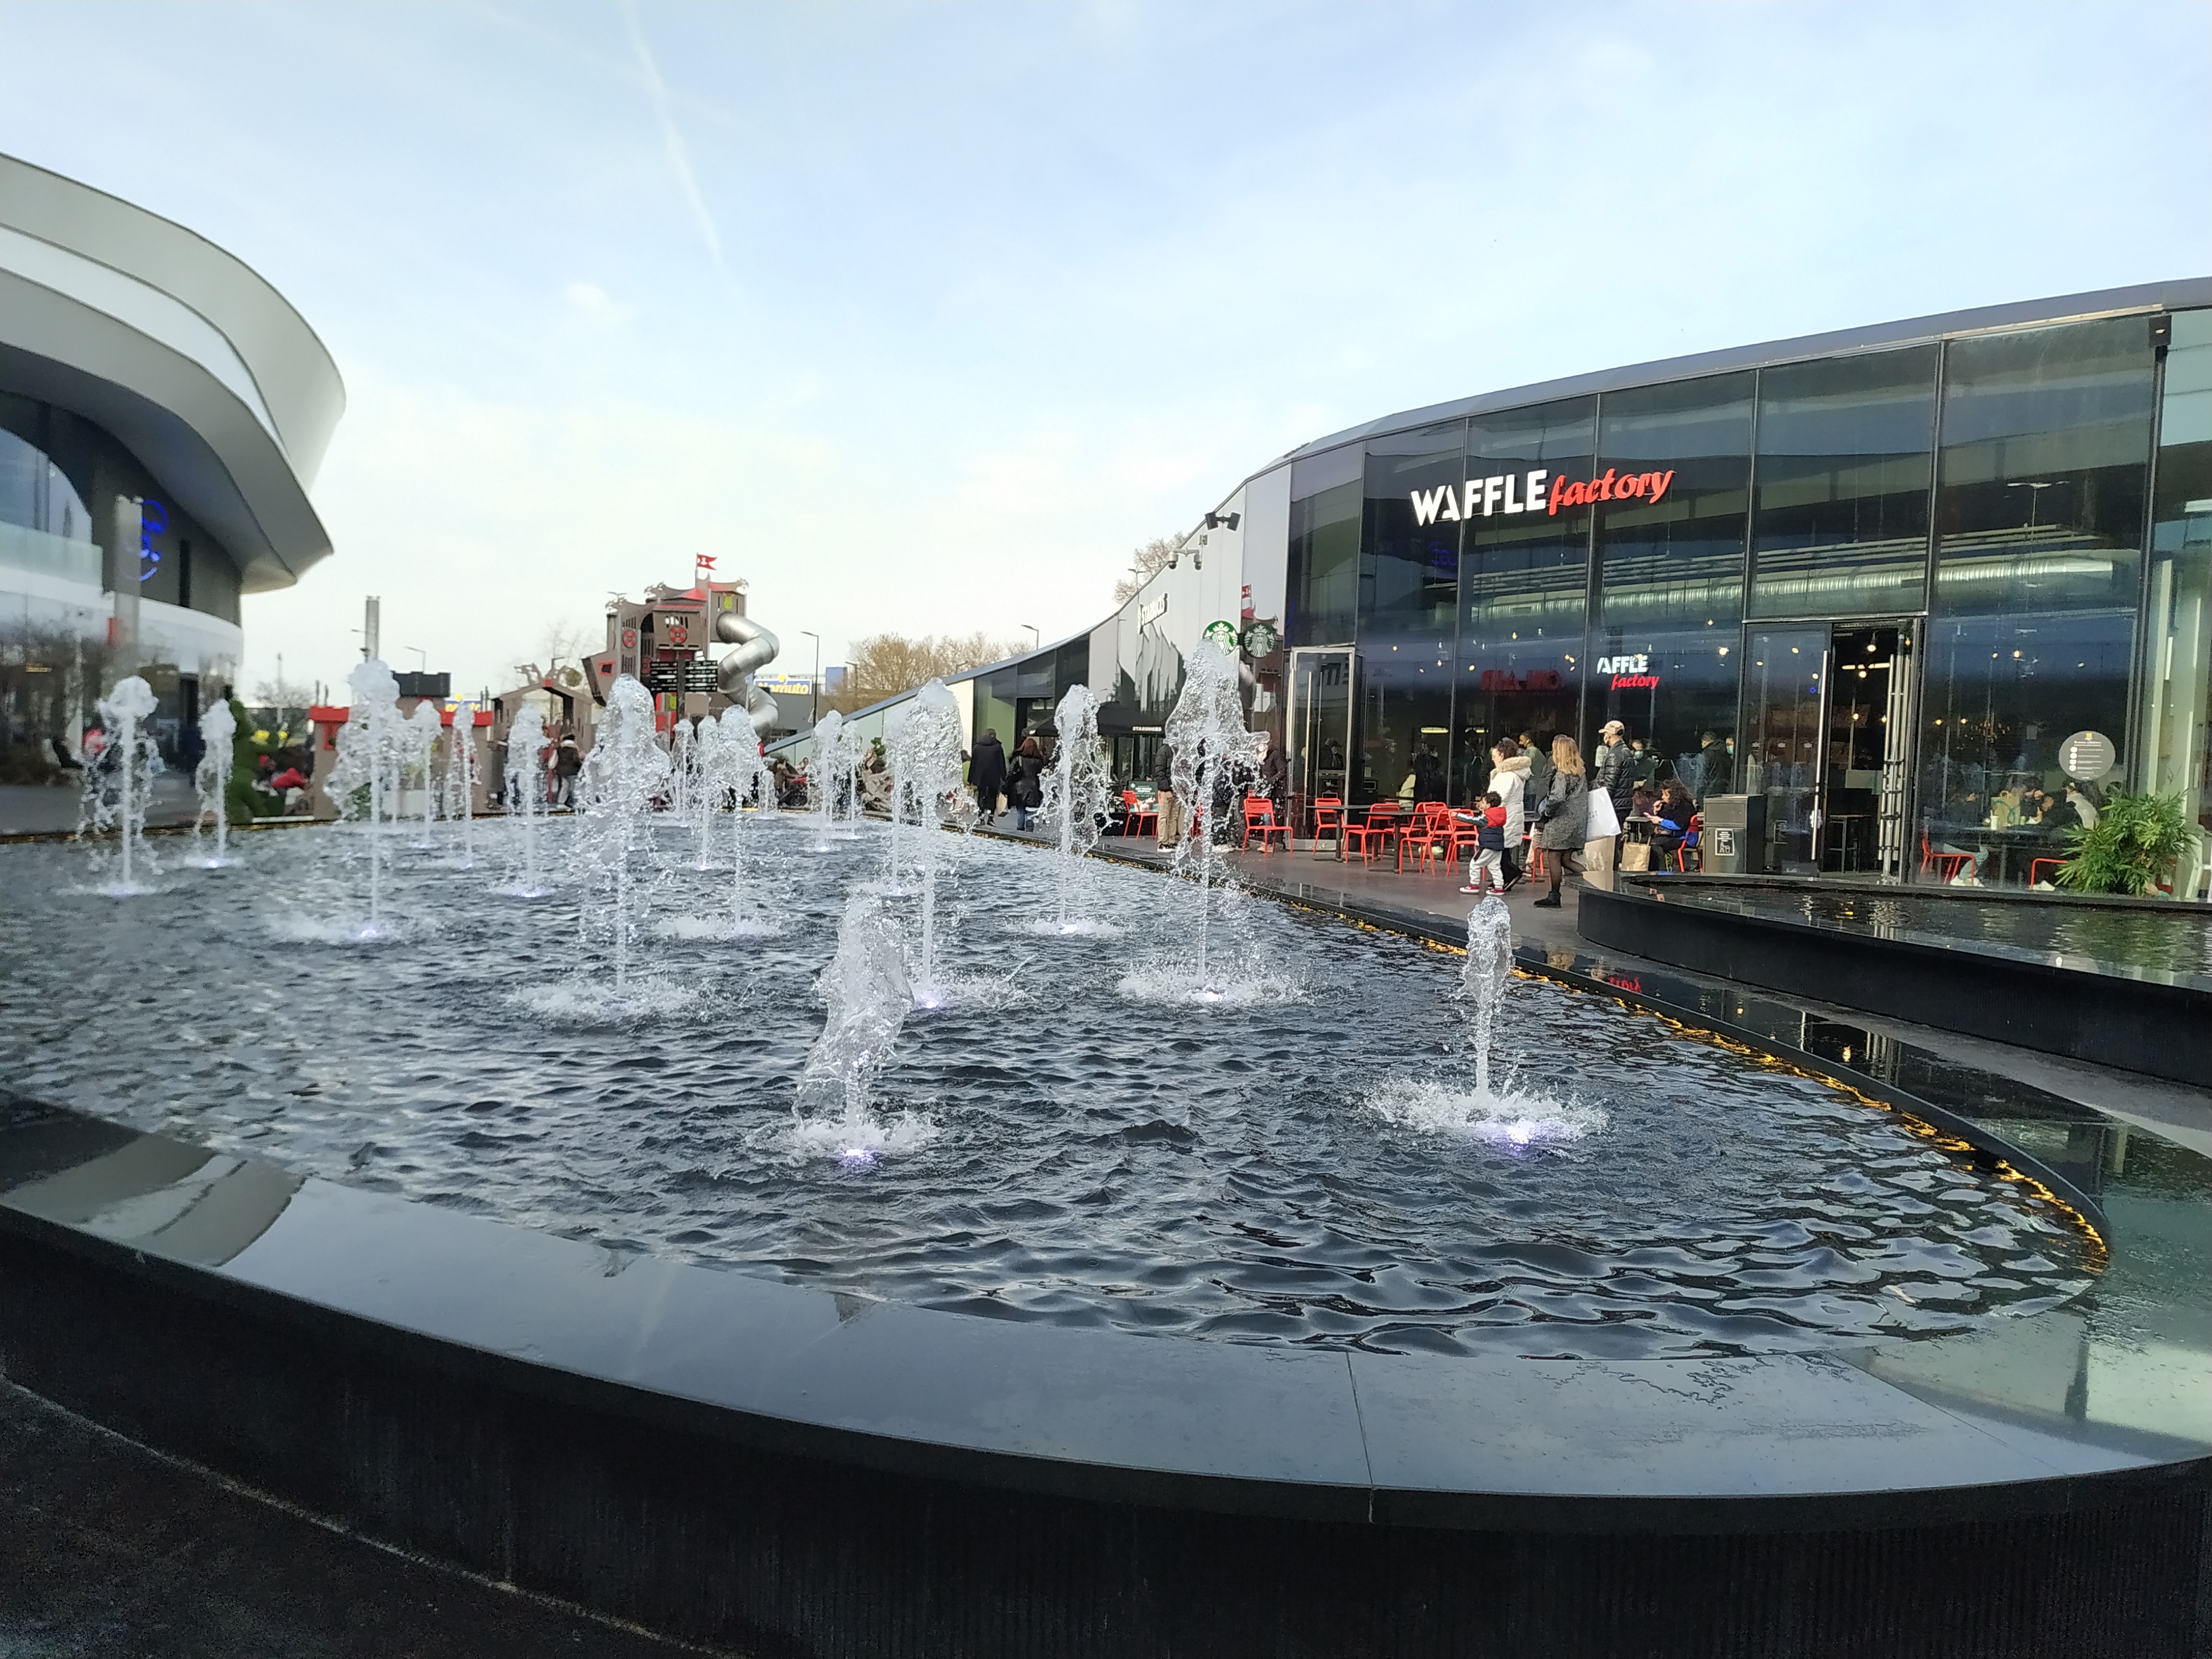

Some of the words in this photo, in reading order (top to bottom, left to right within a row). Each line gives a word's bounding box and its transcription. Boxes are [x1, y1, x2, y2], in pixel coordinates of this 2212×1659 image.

[1411, 469, 1548, 526] WAFFLE
[1548, 468, 1676, 516] factory
[1611, 674, 1660, 691] factory
